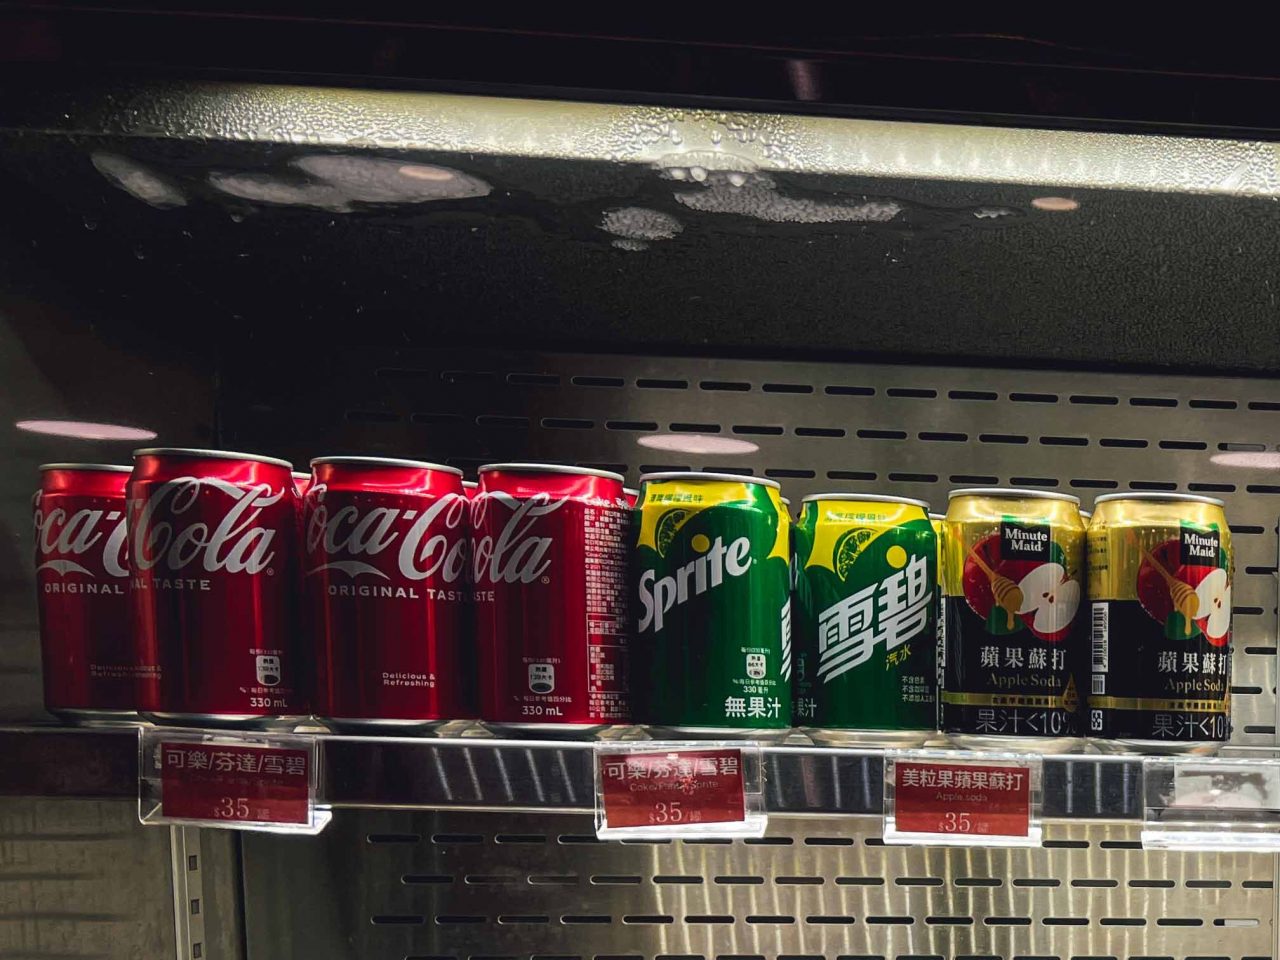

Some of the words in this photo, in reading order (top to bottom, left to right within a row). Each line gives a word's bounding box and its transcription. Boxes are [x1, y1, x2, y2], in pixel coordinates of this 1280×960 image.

[1005, 528, 1048, 542] Minute
[1184, 533, 1219, 547] Minute
[1011, 540, 1043, 552] Maid
[1189, 545, 1215, 558] Maid
[45, 582, 125, 595] ORIGINAL
[155, 578, 211, 590] TASTE
[638, 536, 753, 633] Sprite
[328, 585, 419, 599] ORIGINAL
[427, 588, 465, 601] TAST
[817, 554, 932, 683] 雪碧
[886, 644, 911, 671] 汽水
[981, 646, 1067, 671] 蘋果蘇打
[1158, 651, 1226, 675] 蘋果蘇打
[382, 672, 427, 680] Delicious
[383, 680, 435, 688] Refreshing
[987, 673, 1026, 689] Apple
[1030, 673, 1062, 688] Soda
[1164, 678, 1202, 694] Apple
[250, 697, 271, 707] 330
[273, 698, 289, 708] mL
[725, 696, 782, 718] 無果汁
[522, 705, 543, 716] 330
[545, 706, 564, 717] mL
[167, 750, 306, 775] 可樂/芬達/雪碧
[902, 768, 1023, 791] 美粒果蘋果蘇打
